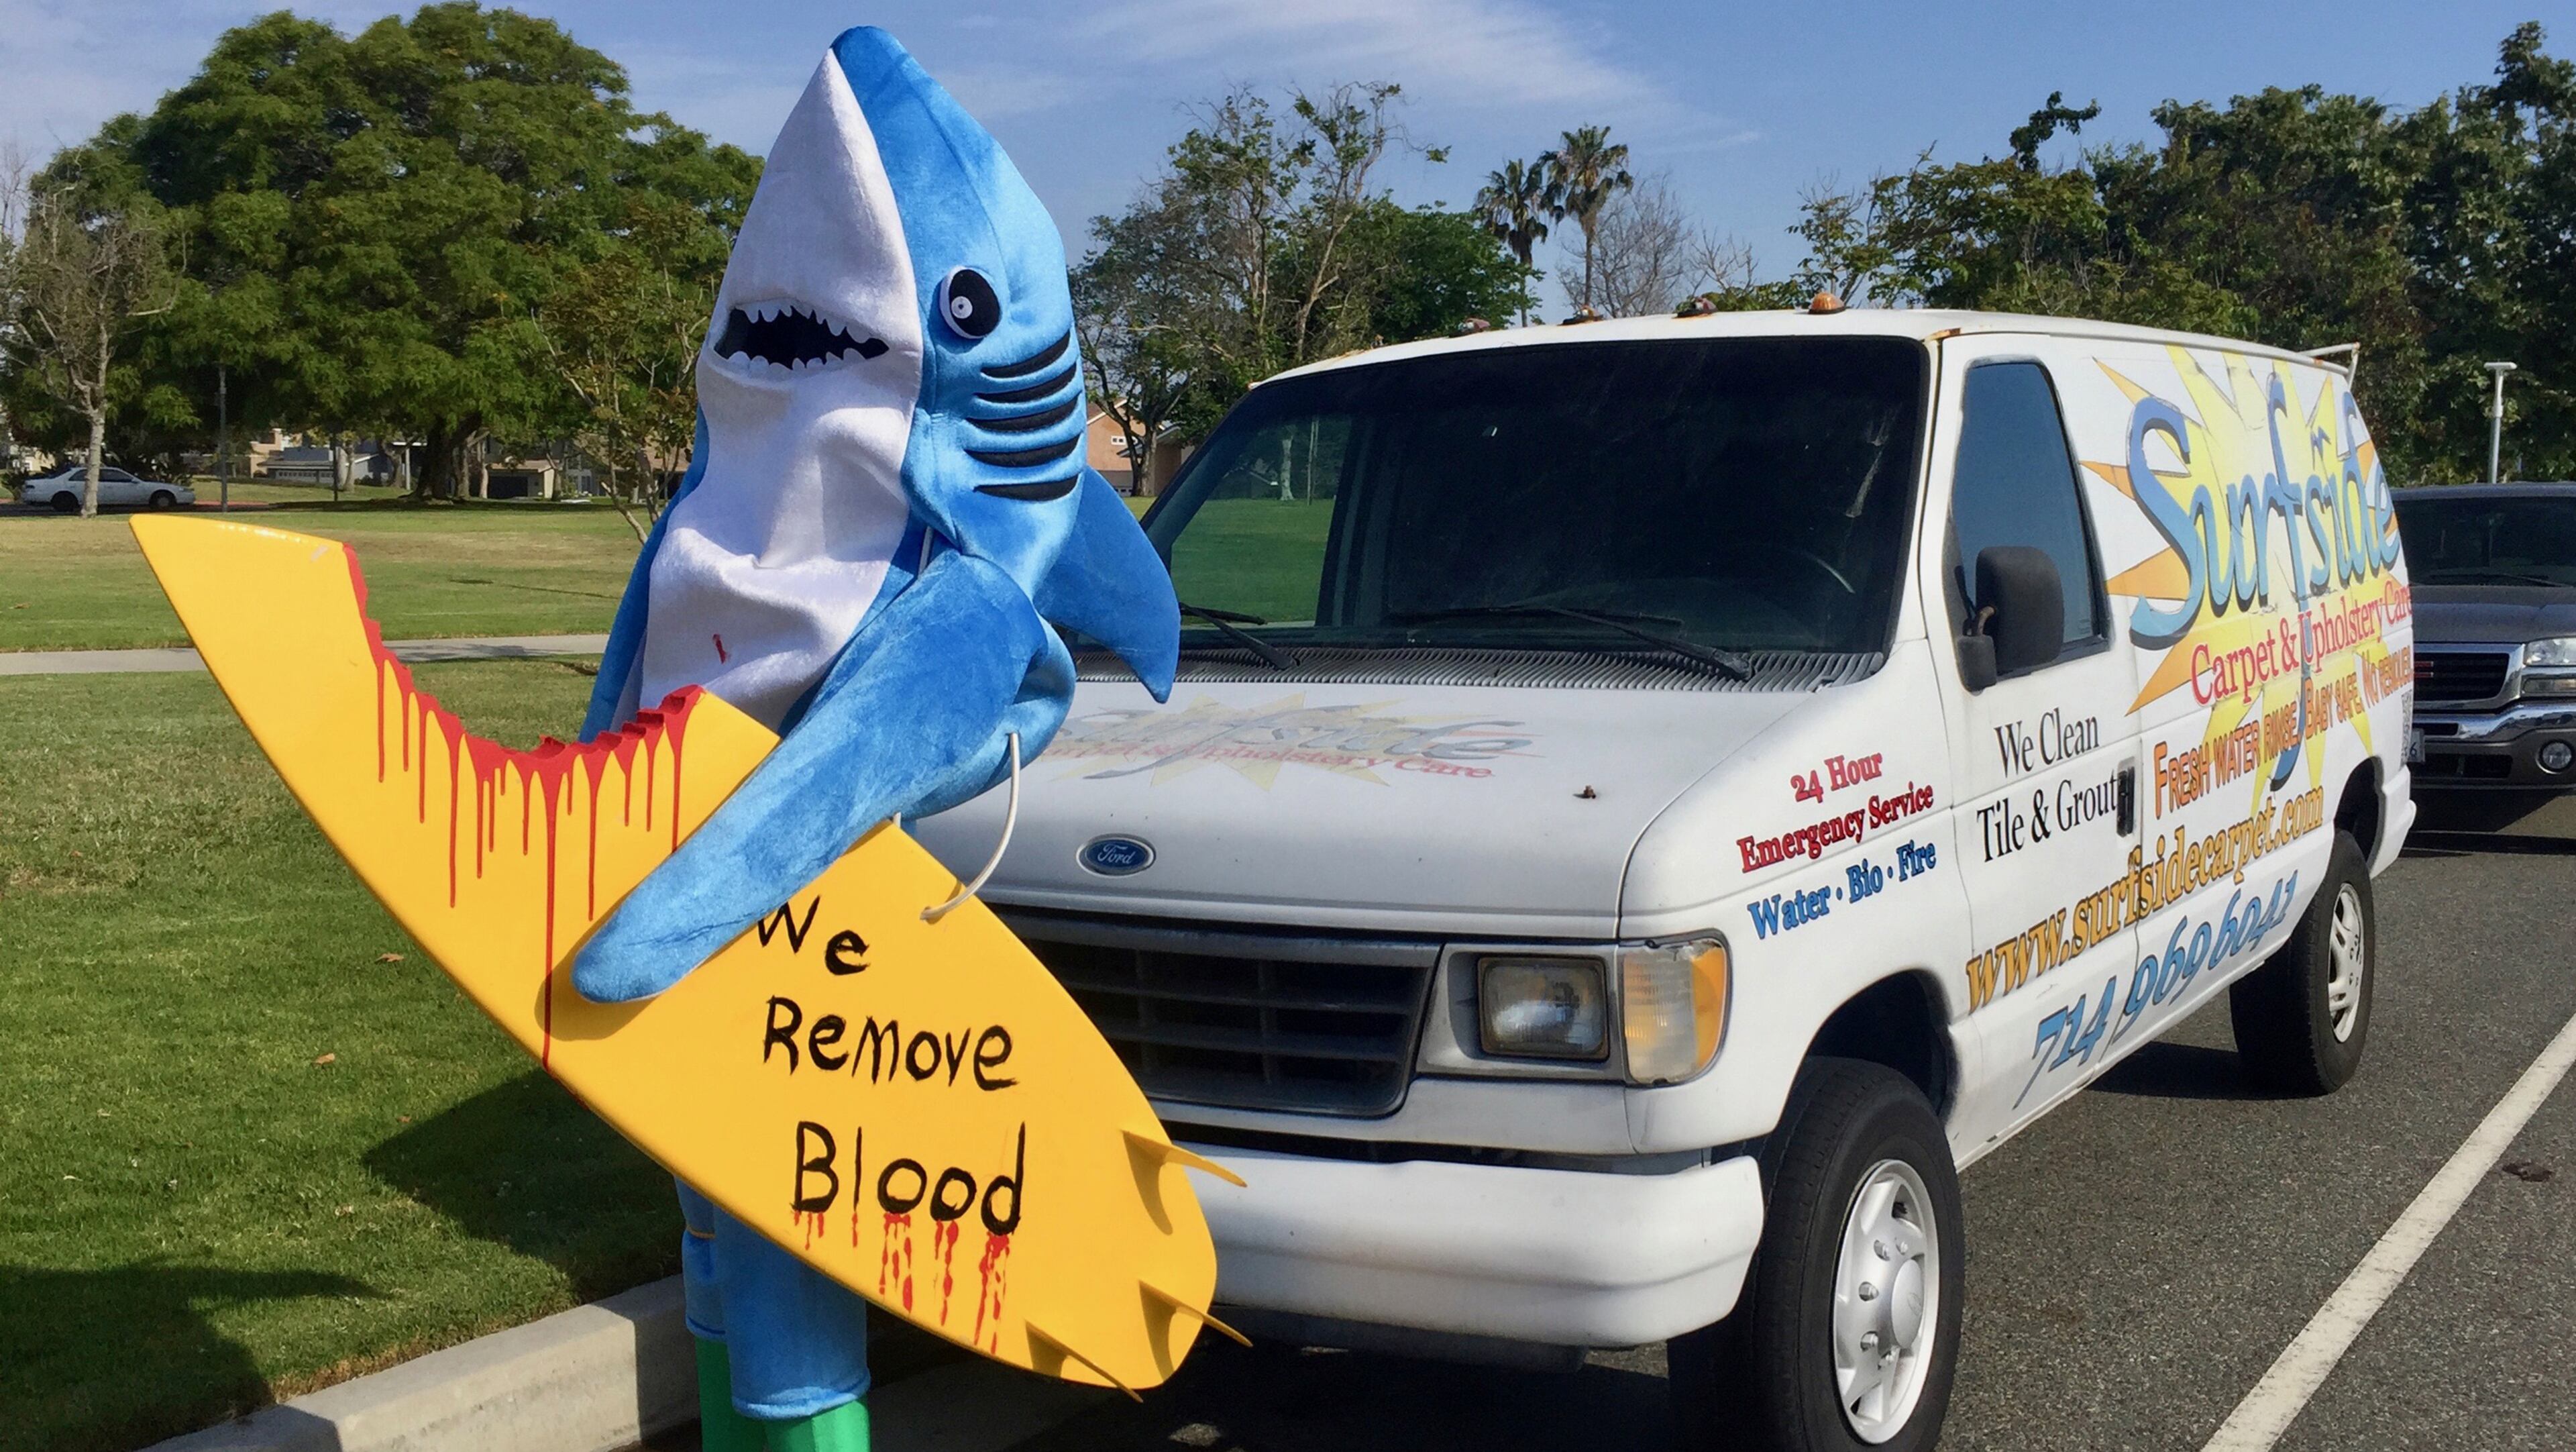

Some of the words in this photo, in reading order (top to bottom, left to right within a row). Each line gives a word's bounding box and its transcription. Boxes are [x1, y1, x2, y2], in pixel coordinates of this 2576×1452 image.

[2127, 372, 2400, 792] Surfside
[2192, 629, 2279, 705] Carpet
[2280, 617, 2299, 672] &
[2298, 596, 2383, 673] Upholstery
[2384, 580, 2413, 625] Care
[1395, 758, 1497, 778] Care
[1790, 772, 1823, 804] 24
[1824, 752, 1882, 792] Hour
[1994, 720, 2033, 778] We
[2039, 707, 2099, 766] Clean
[2214, 719, 2261, 788] WATER
[1097, 843, 1136, 864] Ford
[1736, 807, 1866, 873] Emergency
[1869, 781, 1934, 829] Service
[1976, 803, 2024, 863] Tile
[2031, 789, 2051, 843] &
[2056, 769, 2120, 832] Grout
[757, 895, 871, 976] We
[1747, 884, 1831, 940] Water
[1845, 859, 1883, 904] Bio
[1896, 839, 1937, 882] Fire
[1966, 786, 2324, 1015] www.surfsidecarpet.com
[763, 995, 1021, 1091] Remove
[2013, 976, 2116, 1109] 714
[791, 1121, 1026, 1236] Blood
